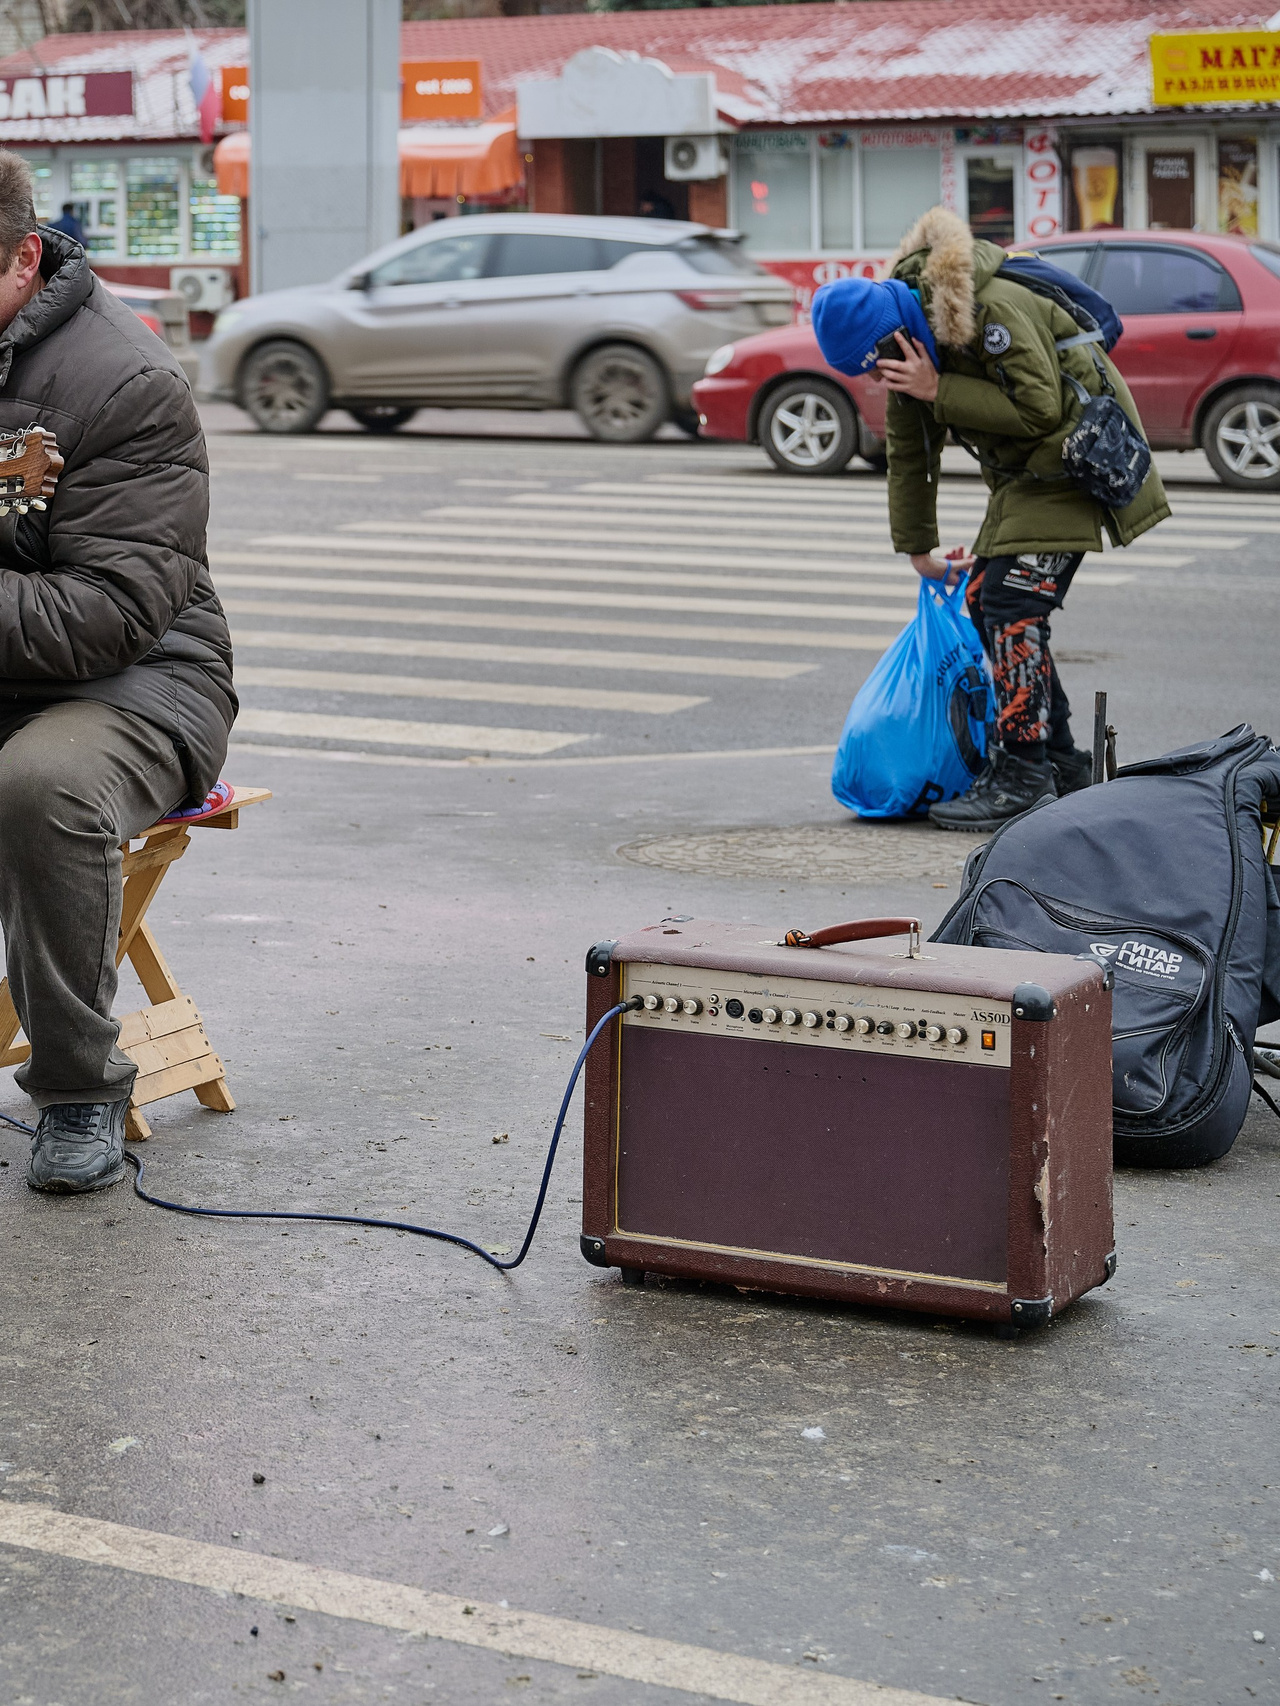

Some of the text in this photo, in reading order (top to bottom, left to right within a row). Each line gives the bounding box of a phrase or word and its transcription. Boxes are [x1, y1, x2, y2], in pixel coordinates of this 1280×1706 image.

[1027, 132, 1058, 238] ФОТО
[1118, 949, 1180, 974] ГИТАР
[1121, 941, 1183, 964] ГИТАР
[970, 1010, 1011, 1024] AS50D
